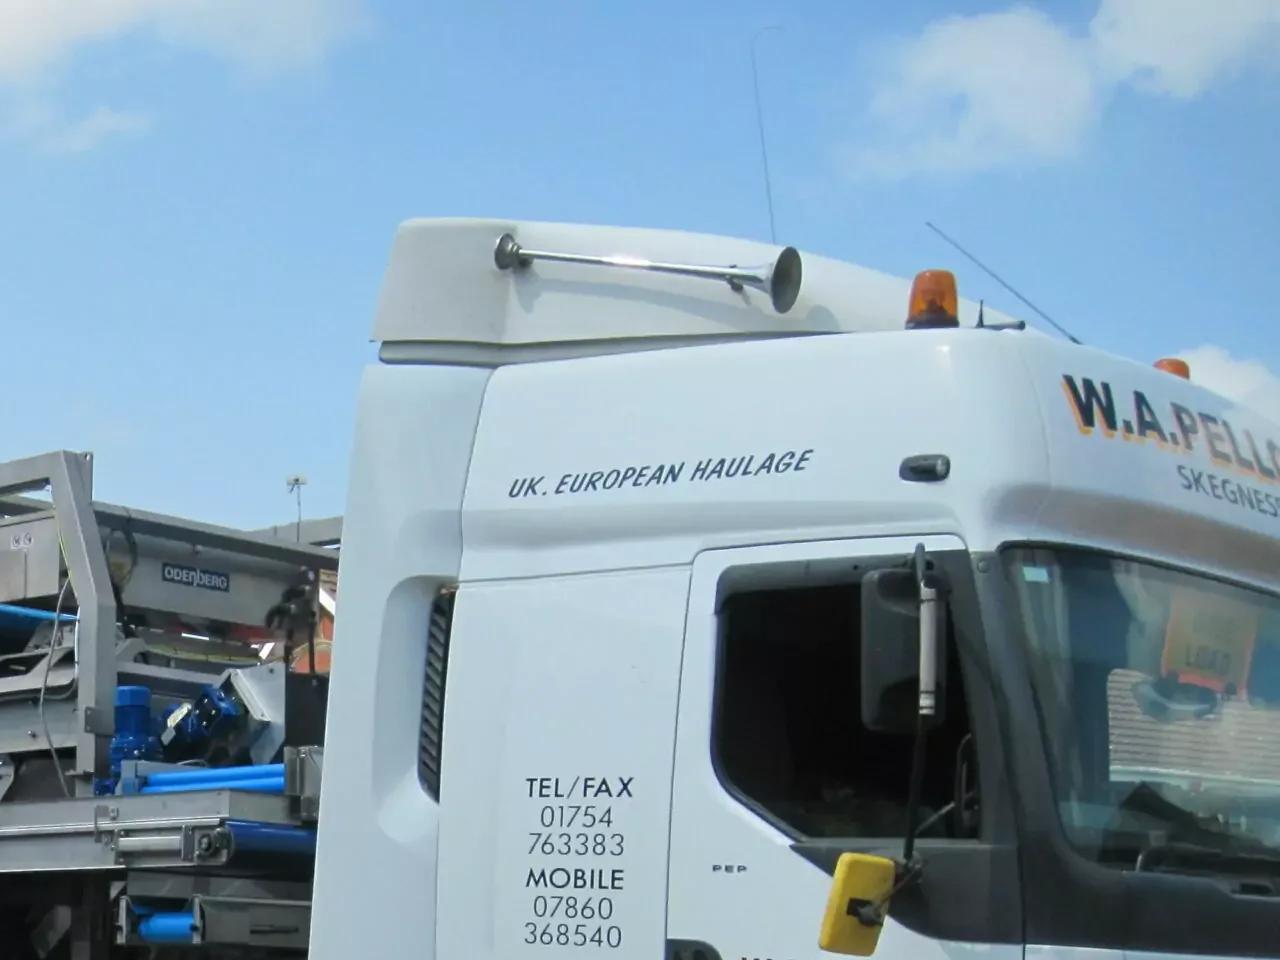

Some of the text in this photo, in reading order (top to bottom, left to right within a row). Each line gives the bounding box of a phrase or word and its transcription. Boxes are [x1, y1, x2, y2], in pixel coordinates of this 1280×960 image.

[508, 448, 815, 499] UK. EUROPEAN HAULAGE
[525, 775, 635, 800] TEL/FAX
[540, 805, 614, 828] 01754
[527, 832, 625, 857] 763383
[525, 867, 625, 891] MOBILE
[533, 895, 613, 920] 07860
[523, 922, 623, 949] 368540
